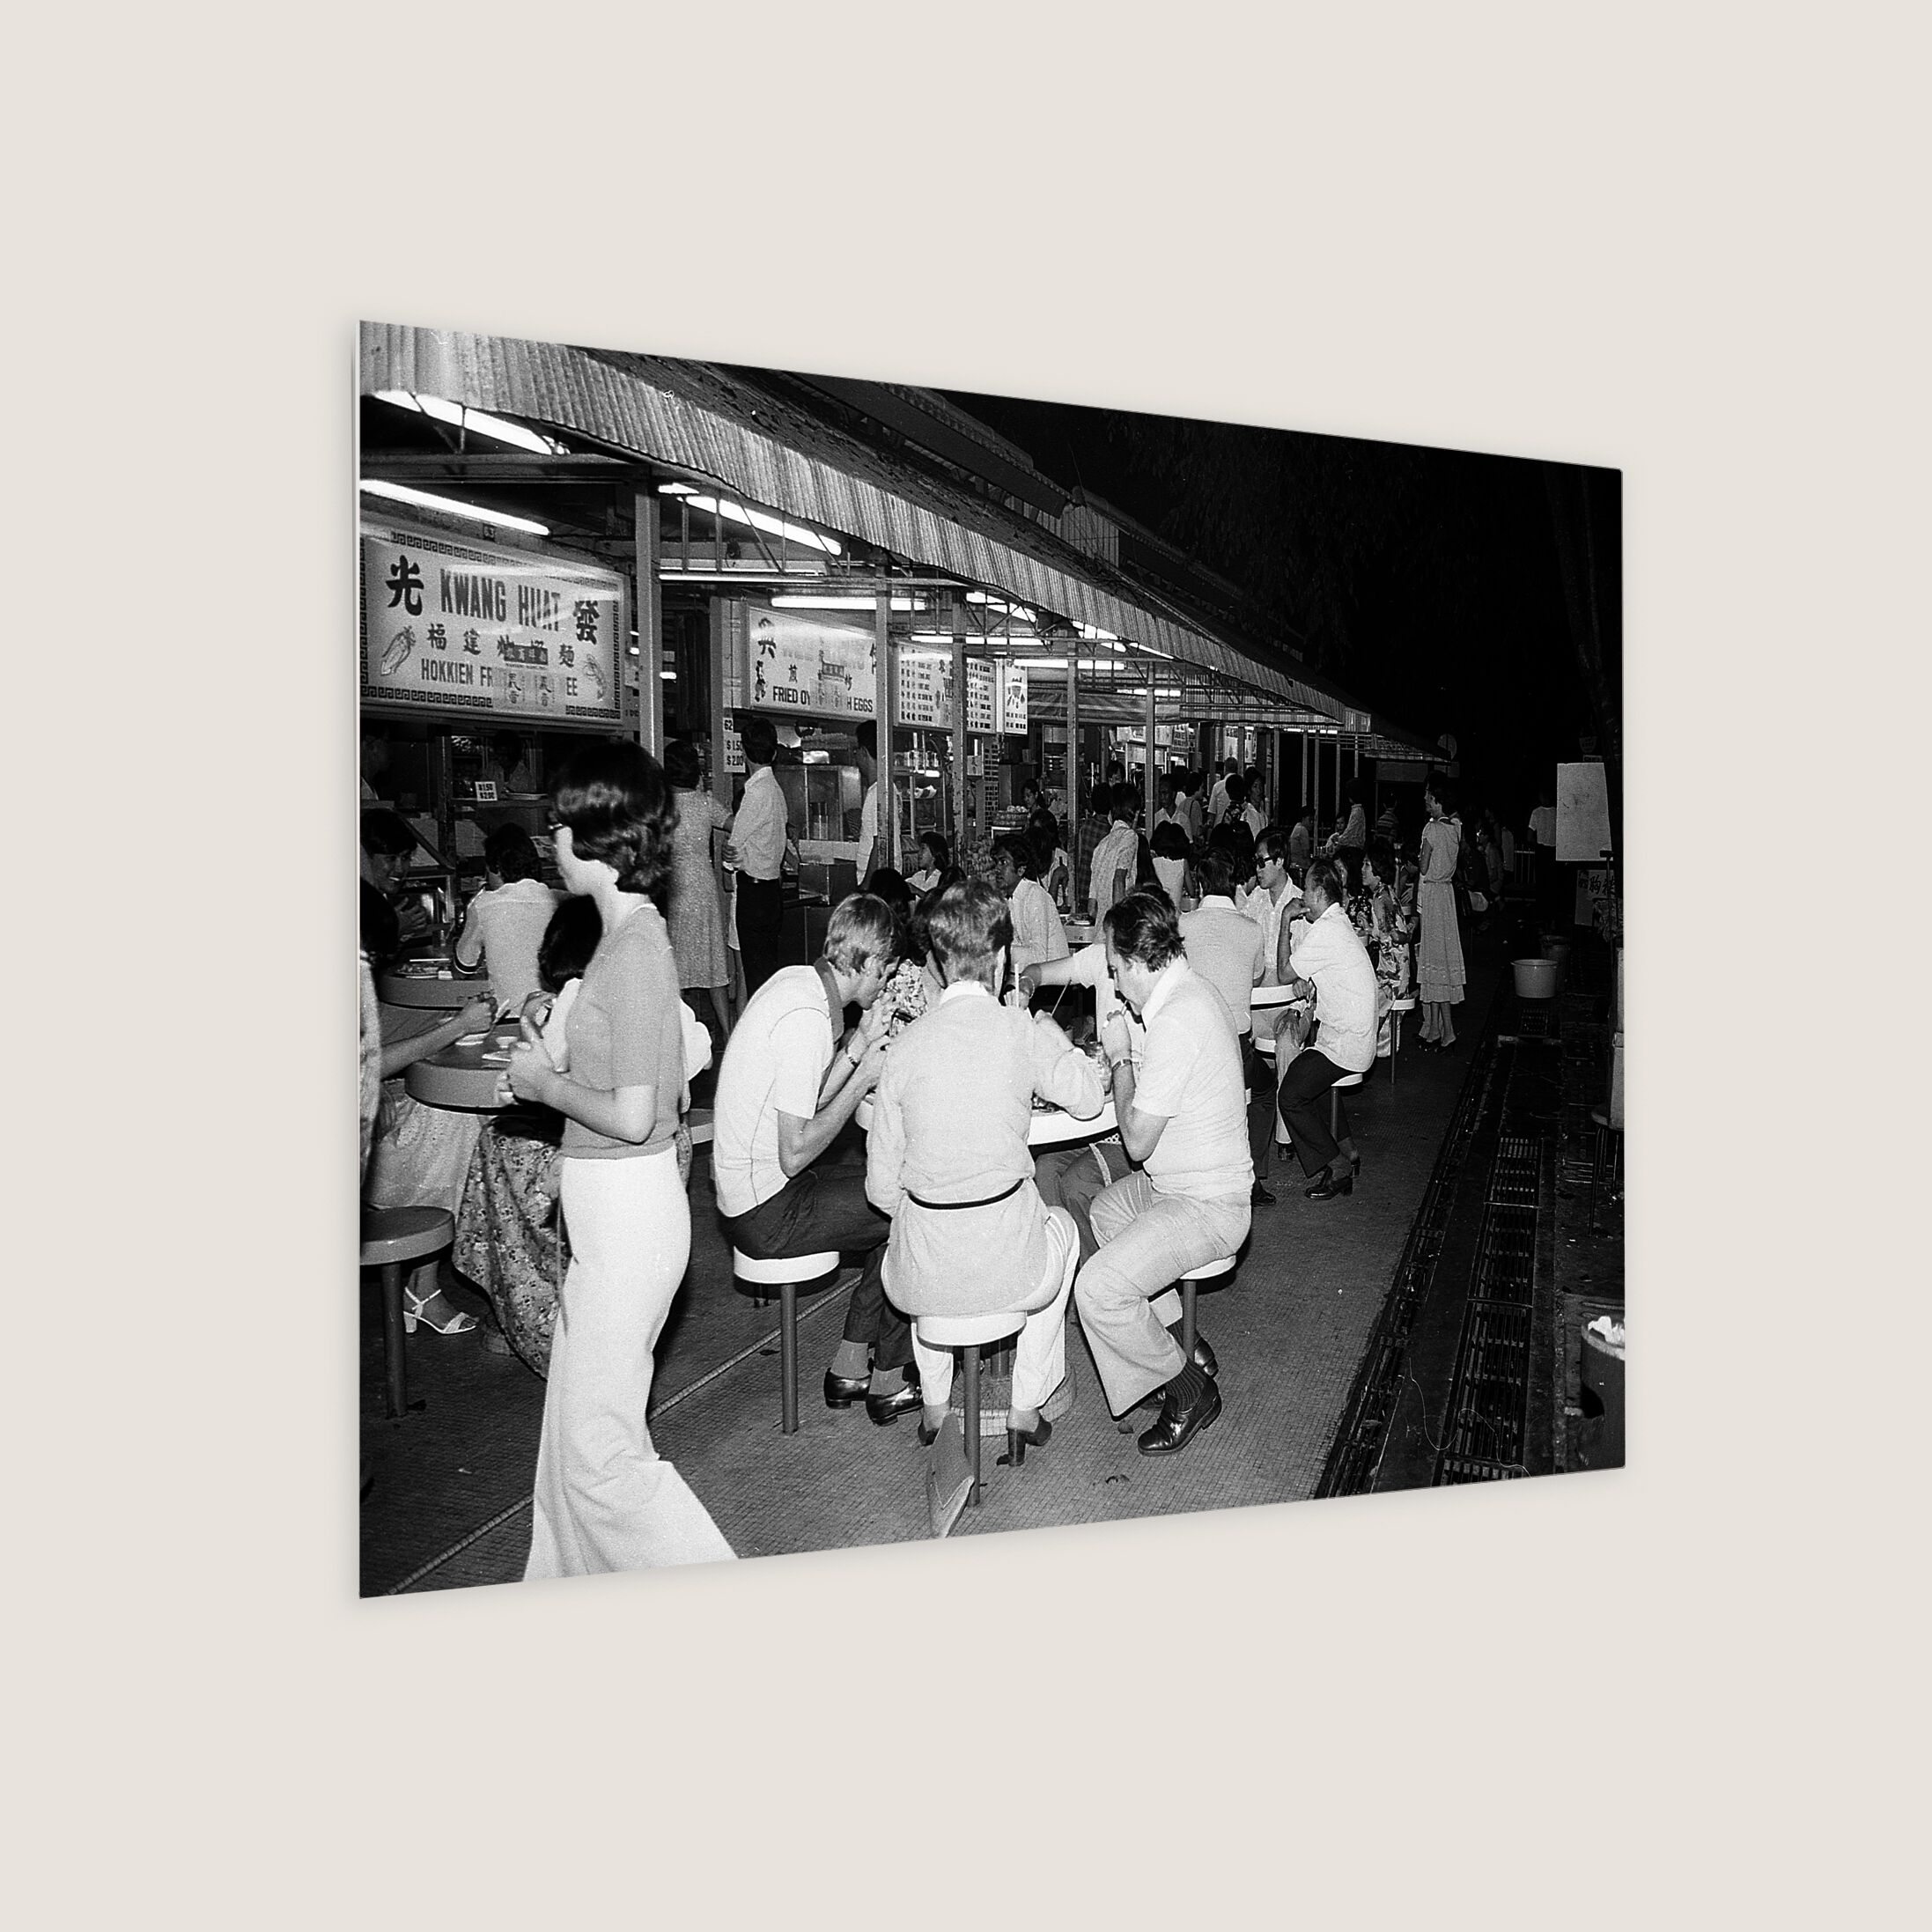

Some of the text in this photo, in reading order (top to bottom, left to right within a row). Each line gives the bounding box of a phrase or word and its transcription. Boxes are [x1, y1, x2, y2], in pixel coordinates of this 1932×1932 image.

[385, 555, 424, 616] 光
[439, 568, 561, 632] KWANG HUAT
[572, 600, 601, 645] 發
[421, 658, 474, 685] HOKKIEN
[772, 686, 799, 704] FRIED
[853, 697, 874, 712] EGGS
